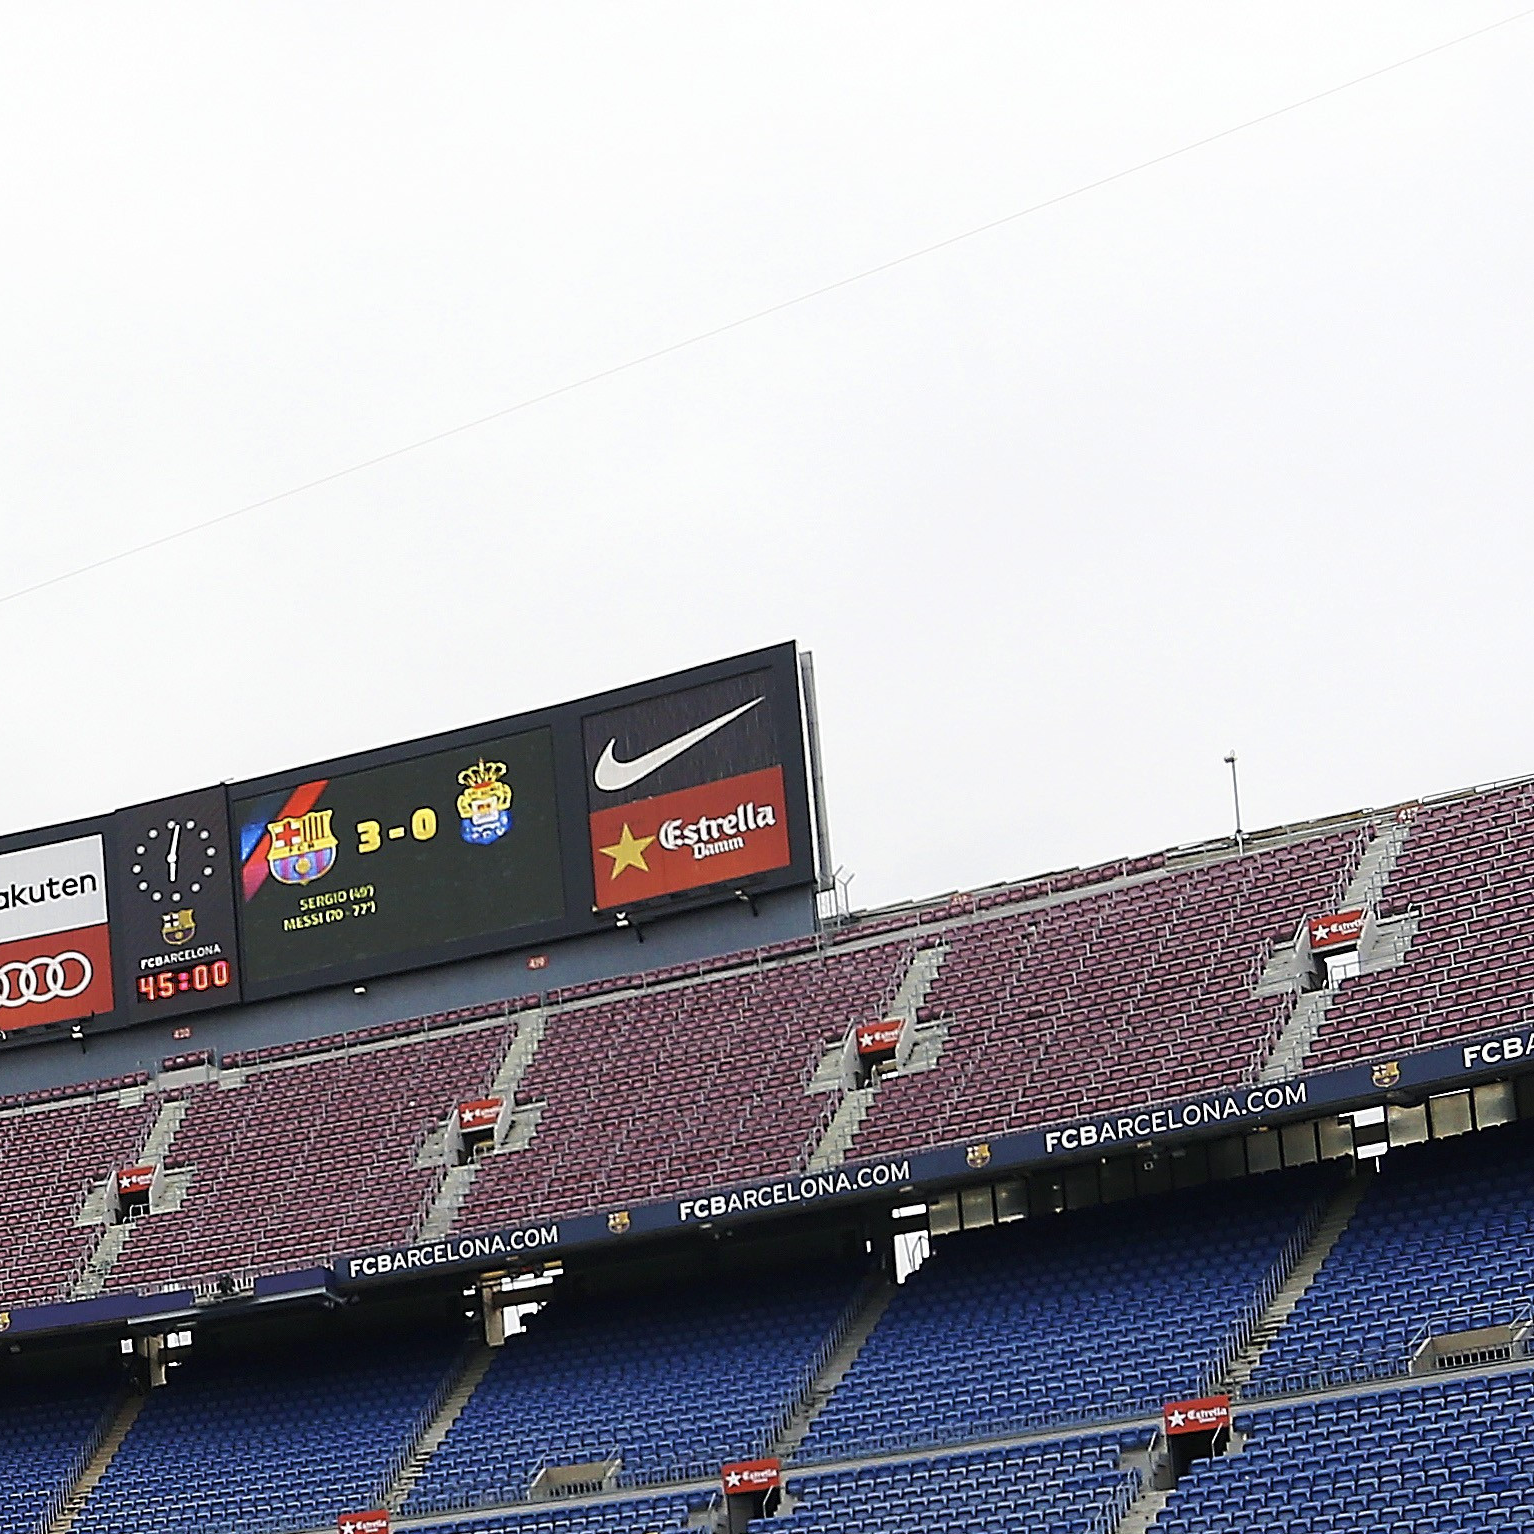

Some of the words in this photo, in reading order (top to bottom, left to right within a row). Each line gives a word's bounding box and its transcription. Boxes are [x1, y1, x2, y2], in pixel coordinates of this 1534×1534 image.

[658, 802, 776, 850] Estrella
[693, 836, 745, 860] Damm
[284, 912, 324, 931] MESSI
[299, 890, 348, 911] SERGIO
[138, 961, 230, 1002] 45:00
[1044, 1082, 1308, 1154] FCBARCELONA.COM
[679, 1161, 910, 1221] FCBARCELONA.COM
[349, 1226, 560, 1278] FCBARCELONA.COM
